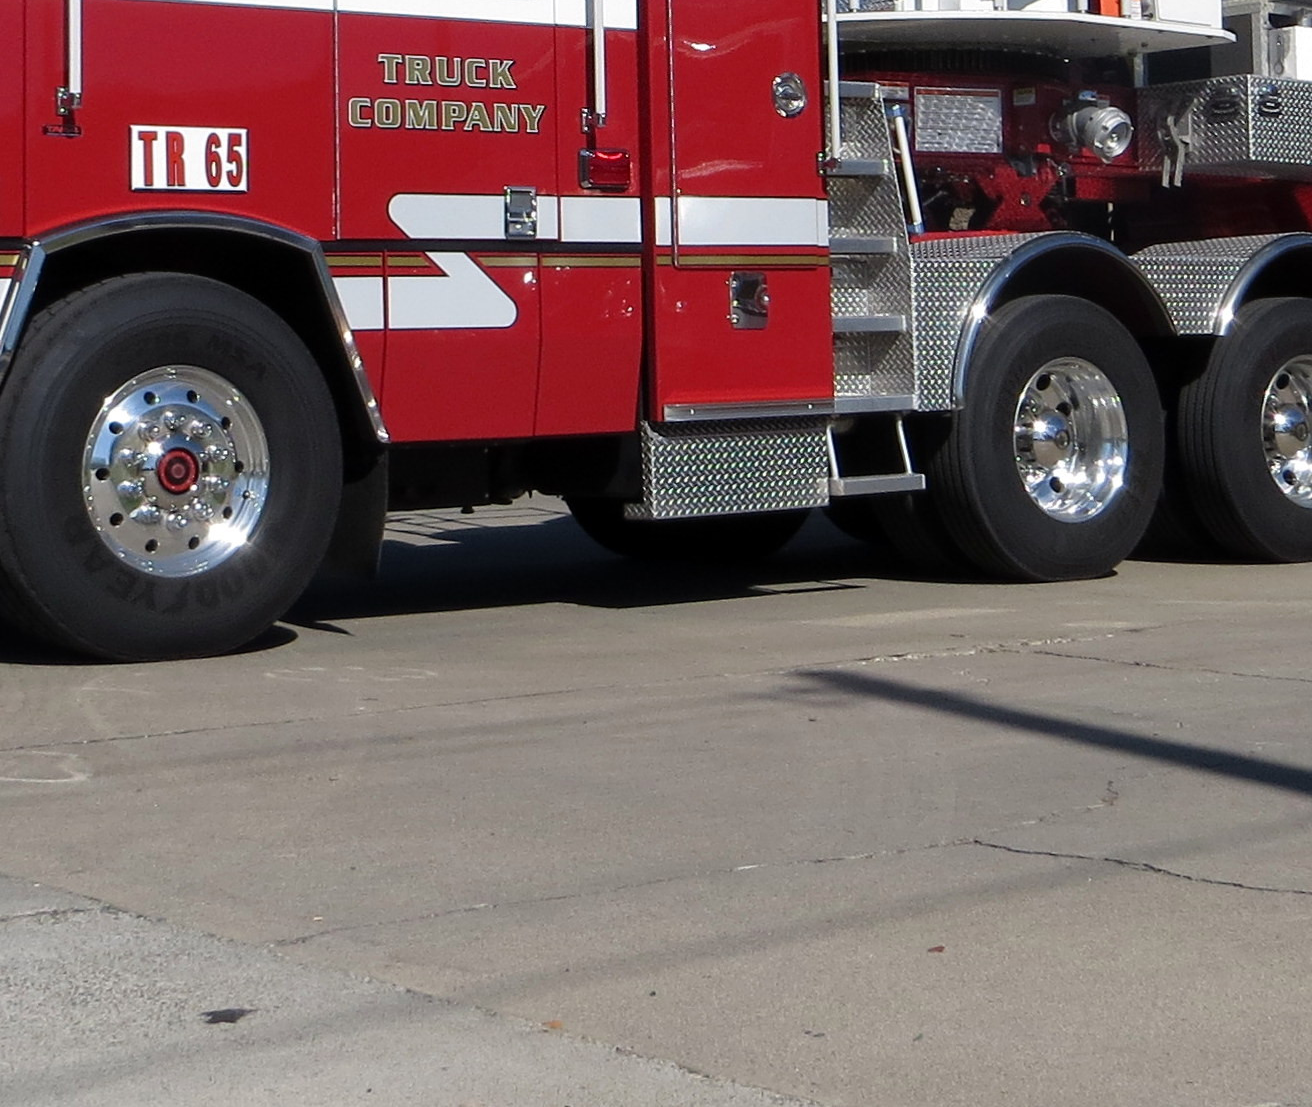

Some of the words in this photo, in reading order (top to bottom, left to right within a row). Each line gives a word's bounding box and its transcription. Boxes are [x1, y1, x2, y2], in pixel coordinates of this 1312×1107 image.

[377, 53, 517, 89] TRUCK
[348, 96, 545, 133] COMPANY
[138, 131, 186, 187] TR
[205, 132, 243, 188] 65
